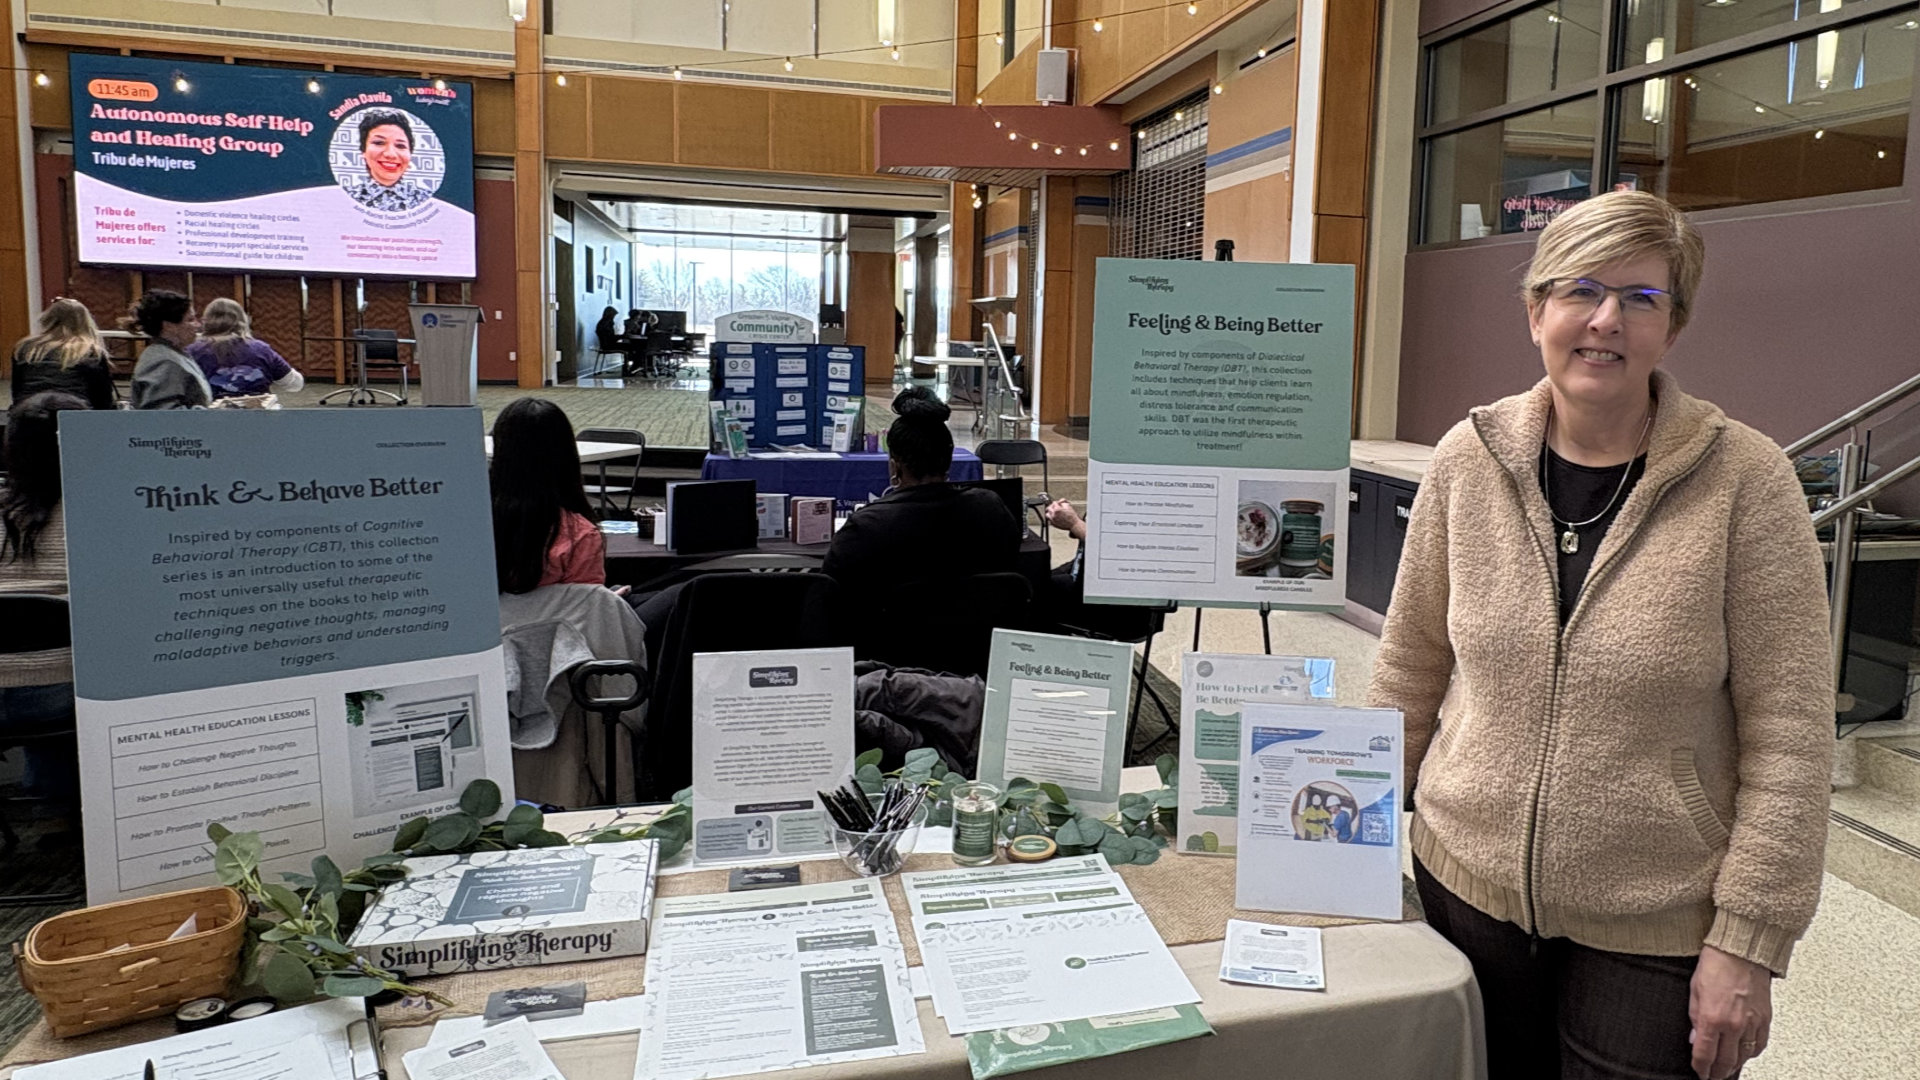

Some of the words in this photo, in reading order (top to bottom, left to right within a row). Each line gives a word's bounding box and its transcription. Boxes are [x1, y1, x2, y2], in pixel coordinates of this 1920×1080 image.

[97, 84, 129, 96] 11:45
[132, 87, 150, 98] am
[359, 91, 392, 105] Davila
[90, 104, 222, 126] Autonomous
[224, 113, 314, 136] Self-Help
[90, 131, 132, 144] and
[135, 131, 216, 155] Healing
[218, 137, 284, 158] Group
[92, 151, 127, 166] Tribu
[128, 152, 144, 167] de
[146, 155, 197, 171] Mujeres
[94, 206, 121, 217] Tribu
[124, 207, 136, 217] de
[95, 221, 136, 232] Mujeres
[137, 222, 166, 233] offers
[96, 236, 136, 245] services
[138, 236, 156, 246] for:
[730, 320, 795, 336] Community
[1128, 313, 1191, 335] Feeling
[1195, 315, 1211, 330] &
[1214, 315, 1264, 335] Being
[1267, 317, 1323, 333] Better
[1141, 348, 1177, 358] Inspired
[1178, 350, 1190, 359] by
[1191, 352, 1244, 360] components
[1246, 352, 1256, 360] of
[1133, 361, 1180, 371] Behavioral
[1183, 362, 1219, 373] Therapy
[1252, 365, 1267, 374] this
[1269, 366, 1312, 375] collection
[1132, 374, 1167, 383] includes
[1169, 376, 1216, 386] techniques
[1218, 377, 1236, 386] that
[1238, 378, 1257, 387] help
[1259, 379, 1288, 387] clients
[1291, 380, 1312, 388] learn
[1143, 388, 1169, 396] about
[1227, 391, 1263, 400] emotion
[1139, 401, 1173, 410] distress
[1175, 402, 1216, 411] tolerance
[1218, 404, 1235, 412] and
[1236, 405, 1303, 413] communication
[1171, 414, 1190, 423] DBT
[1192, 416, 1209, 424] was
[1211, 416, 1225, 424] the
[1227, 416, 1245, 425] first
[1247, 417, 1297, 427] therapeutic
[1138, 428, 1179, 437] approach
[1181, 428, 1191, 436] to
[1193, 429, 1219, 437] utilize
[1221, 430, 1274, 439] mindfulness
[1275, 431, 1303, 440] within
[128, 437, 203, 450] Simplifying
[160, 447, 212, 459] Therapy
[134, 483, 220, 512] Think
[228, 480, 274, 504] &
[278, 478, 365, 504] Behave
[368, 476, 444, 498] Better
[1397, 505, 1410, 518] TRA
[168, 529, 229, 546] Inspired
[234, 528, 252, 541] by
[256, 523, 341, 539] components
[345, 521, 358, 533] of
[362, 518, 424, 533] Cognitive
[152, 548, 234, 565] Behavioral
[239, 546, 299, 559] Therapy
[303, 540, 346, 554] (CBT),
[351, 539, 374, 550] this
[378, 536, 439, 549] collection
[162, 570, 207, 584] series
[212, 568, 223, 579] is
[228, 568, 245, 579] an
[251, 561, 336, 576] introduction
[340, 559, 354, 569] to
[357, 557, 392, 568] some
[396, 553, 410, 564] of
[413, 552, 433, 562] the
[179, 588, 216, 601] most
[221, 581, 298, 597] universally
[303, 577, 344, 590] useful
[348, 571, 423, 586] therapeutic
[174, 605, 255, 621] techniques
[260, 602, 277, 613] on
[283, 599, 305, 611] the
[309, 595, 350, 608] books
[353, 593, 367, 603] to
[371, 590, 399, 602] help
[403, 587, 429, 599] with
[155, 624, 244, 642] challenging
[249, 618, 310, 634] negative
[315, 610, 378, 625] thoughts,
[382, 604, 446, 618] managing
[153, 643, 248, 662] maladaptive
[254, 635, 322, 651] behaviors
[327, 629, 353, 642] and
[356, 620, 449, 639] understanding
[281, 652, 339, 667] triggers.
[1009, 662, 1043, 676] Feeling
[1043, 664, 1053, 674] &
[1054, 666, 1080, 680] Being
[1081, 669, 1112, 681] Better
[1196, 682, 1220, 692] How
[1223, 683, 1235, 693] to
[1236, 684, 1258, 694] Feel
[1196, 695, 1209, 704] Be
[117, 731, 162, 745] MENTAL
[164, 724, 205, 737] HEALTH
[208, 715, 266, 731] EDUCATION
[268, 709, 310, 722] LESSONS
[138, 763, 159, 773] How
[161, 760, 171, 768] to
[172, 753, 217, 767] Challenge
[219, 747, 257, 760] Negative
[258, 740, 297, 753] Thoughts
[1294, 748, 1325, 756] TRAINING
[1307, 756, 1355, 766] WORKFORCE
[137, 793, 157, 803] How
[160, 790, 169, 799] to
[171, 784, 211, 798] Establish
[213, 775, 258, 790] Behavioral
[260, 769, 299, 782] Discipline
[400, 808, 433, 820] EXAMPLE
[434, 805, 444, 813] OF
[130, 831, 152, 841] How
[154, 828, 163, 836] to
[165, 821, 203, 834] Promote
[241, 807, 277, 819] Thought
[353, 824, 397, 839] CHALLENGE
[380, 937, 517, 967] Simplifying
